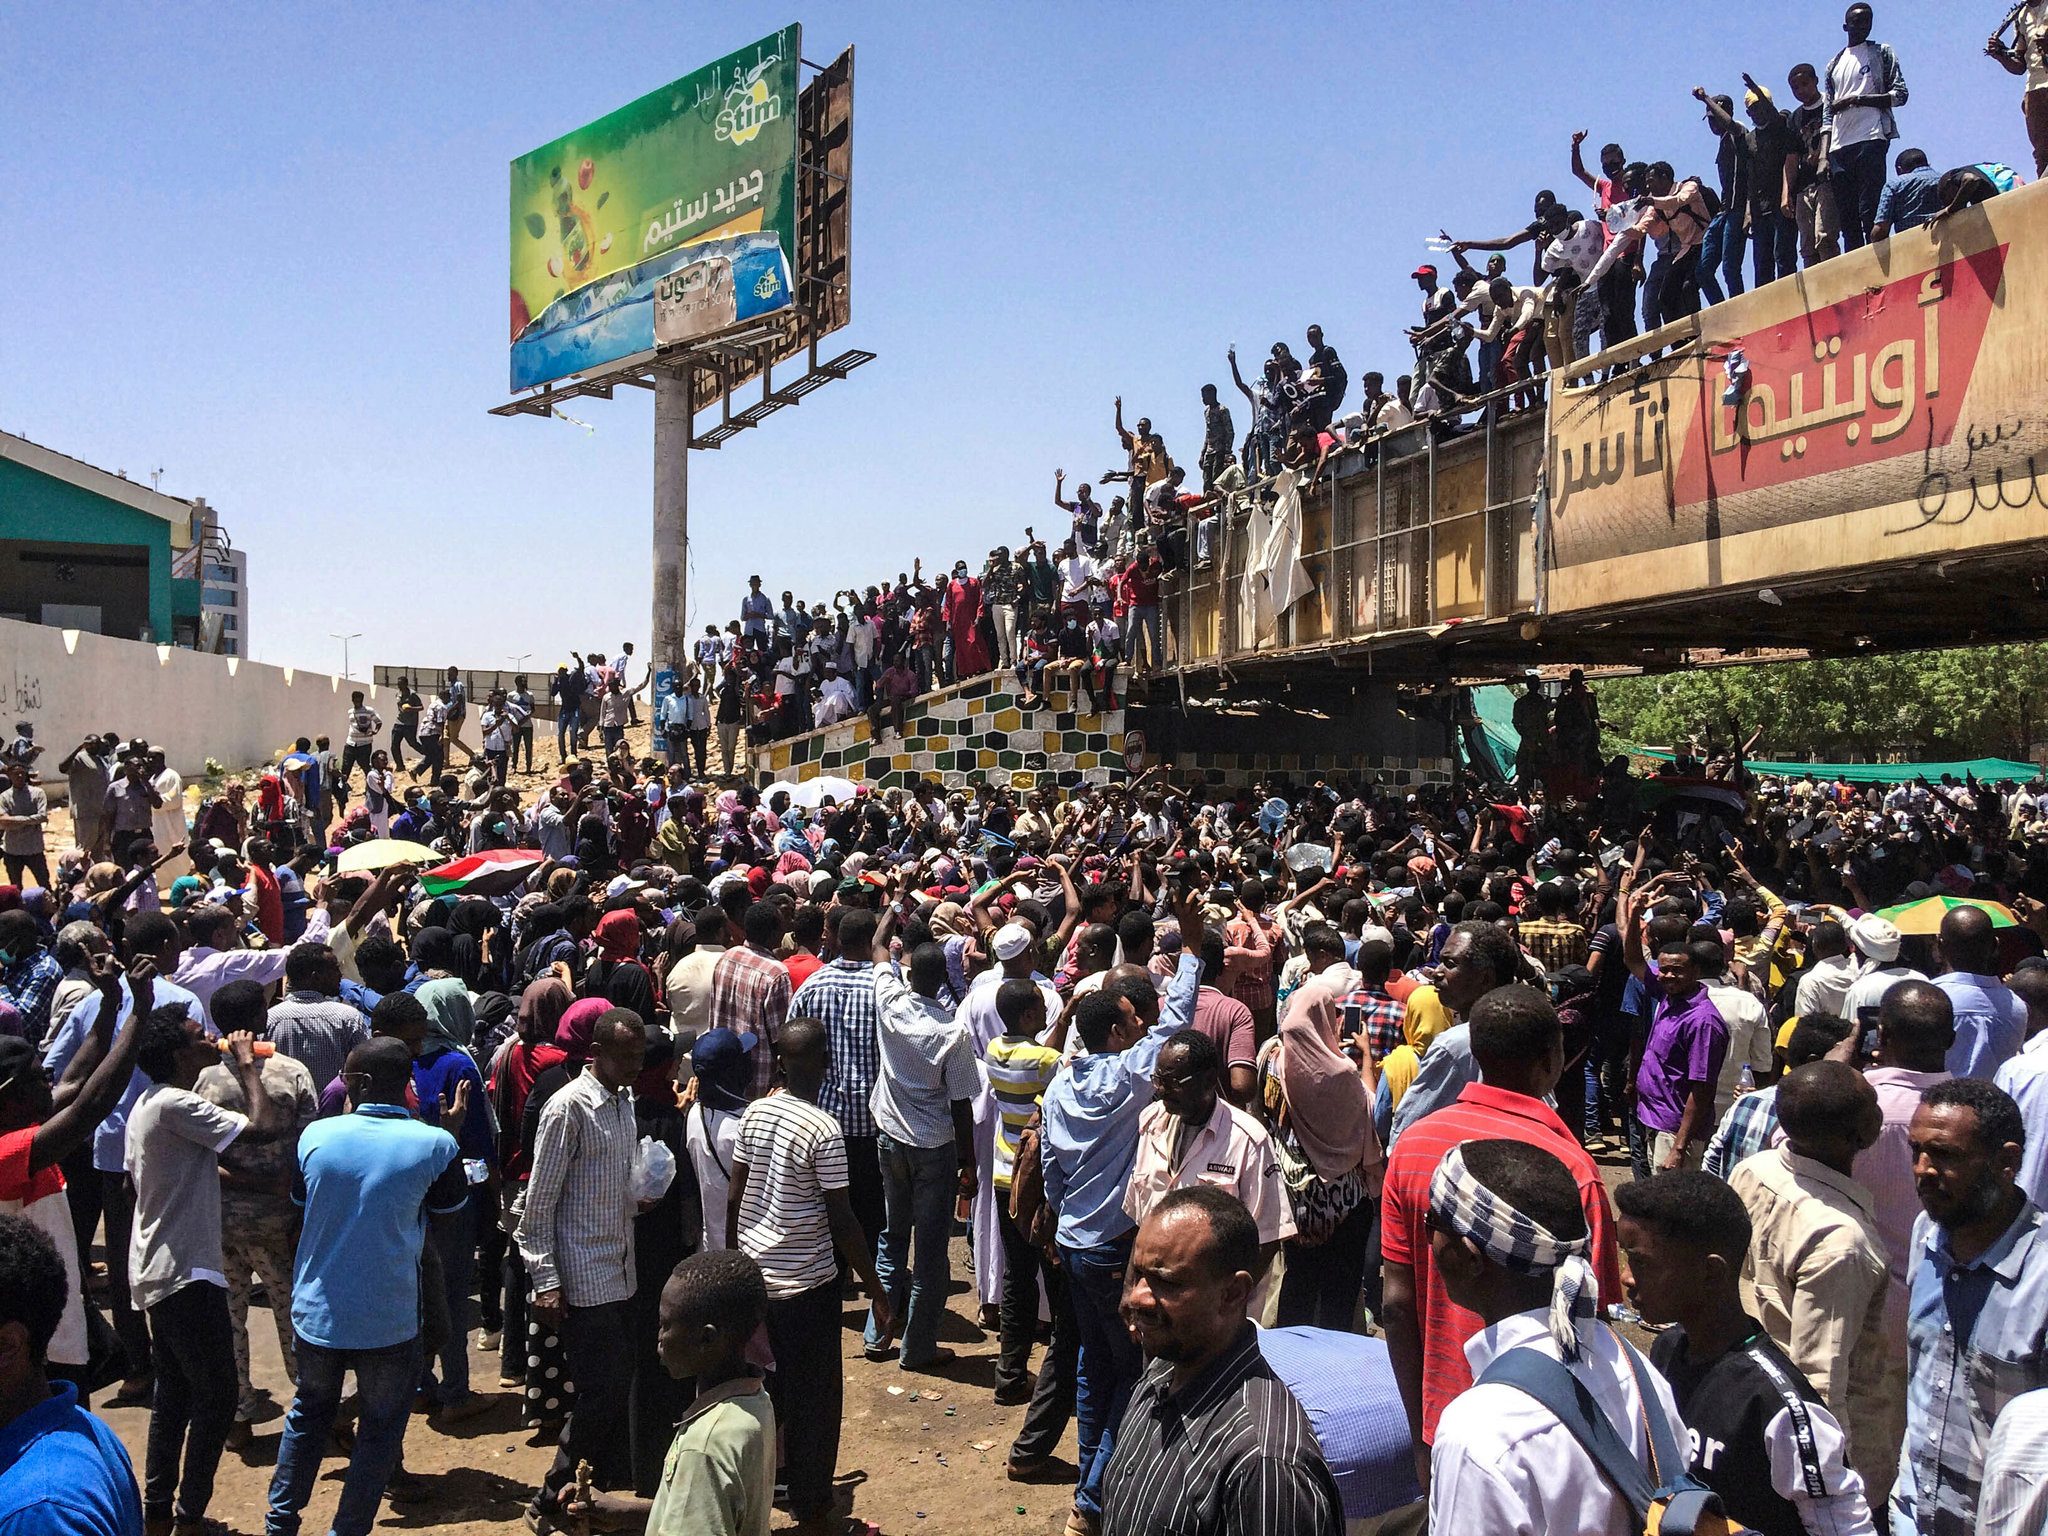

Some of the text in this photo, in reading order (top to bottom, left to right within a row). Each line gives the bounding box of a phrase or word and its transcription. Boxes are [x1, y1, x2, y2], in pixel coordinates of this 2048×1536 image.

[715, 94, 781, 141] Stim
[643, 169, 763, 253] جديد ستيم
[753, 278, 781, 297] Stim
[1711, 269, 1941, 456] أوبتيما
